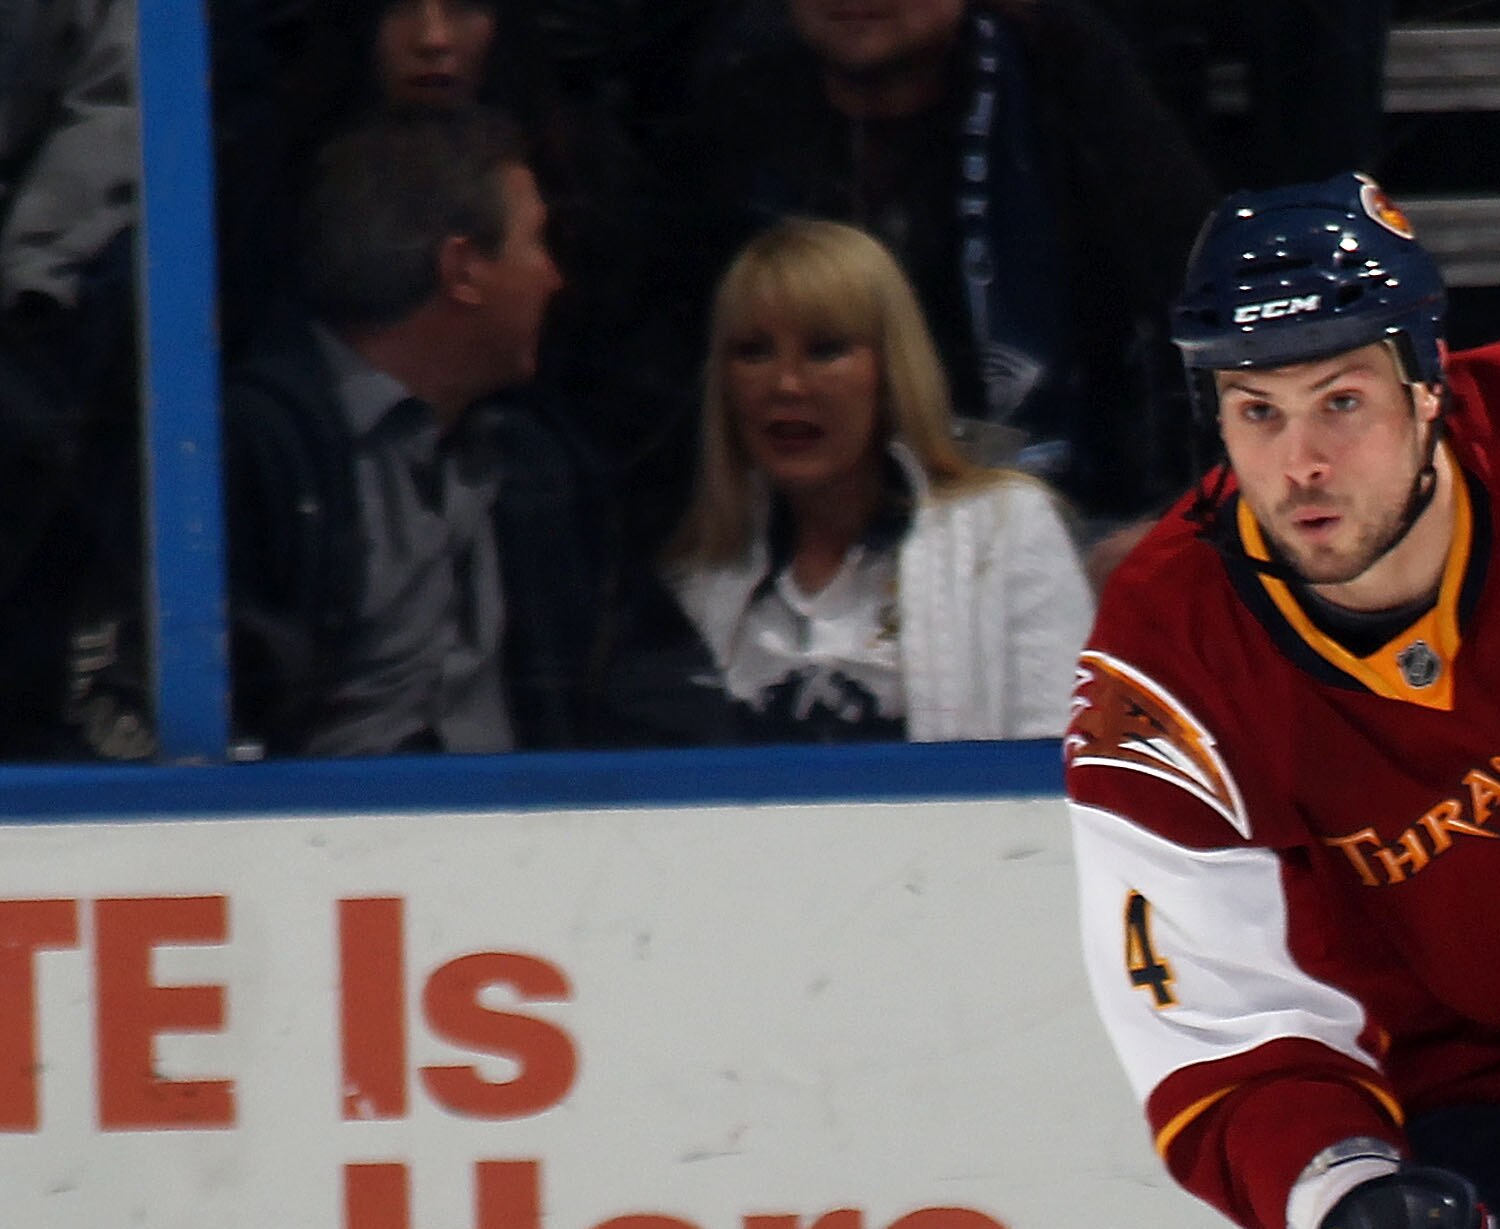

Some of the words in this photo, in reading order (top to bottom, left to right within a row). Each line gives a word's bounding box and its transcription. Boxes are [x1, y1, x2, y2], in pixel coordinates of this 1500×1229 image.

[1234, 294, 1322, 323] CCM
[336, 895, 582, 1122] Is
[1122, 889, 1178, 1009] 4
